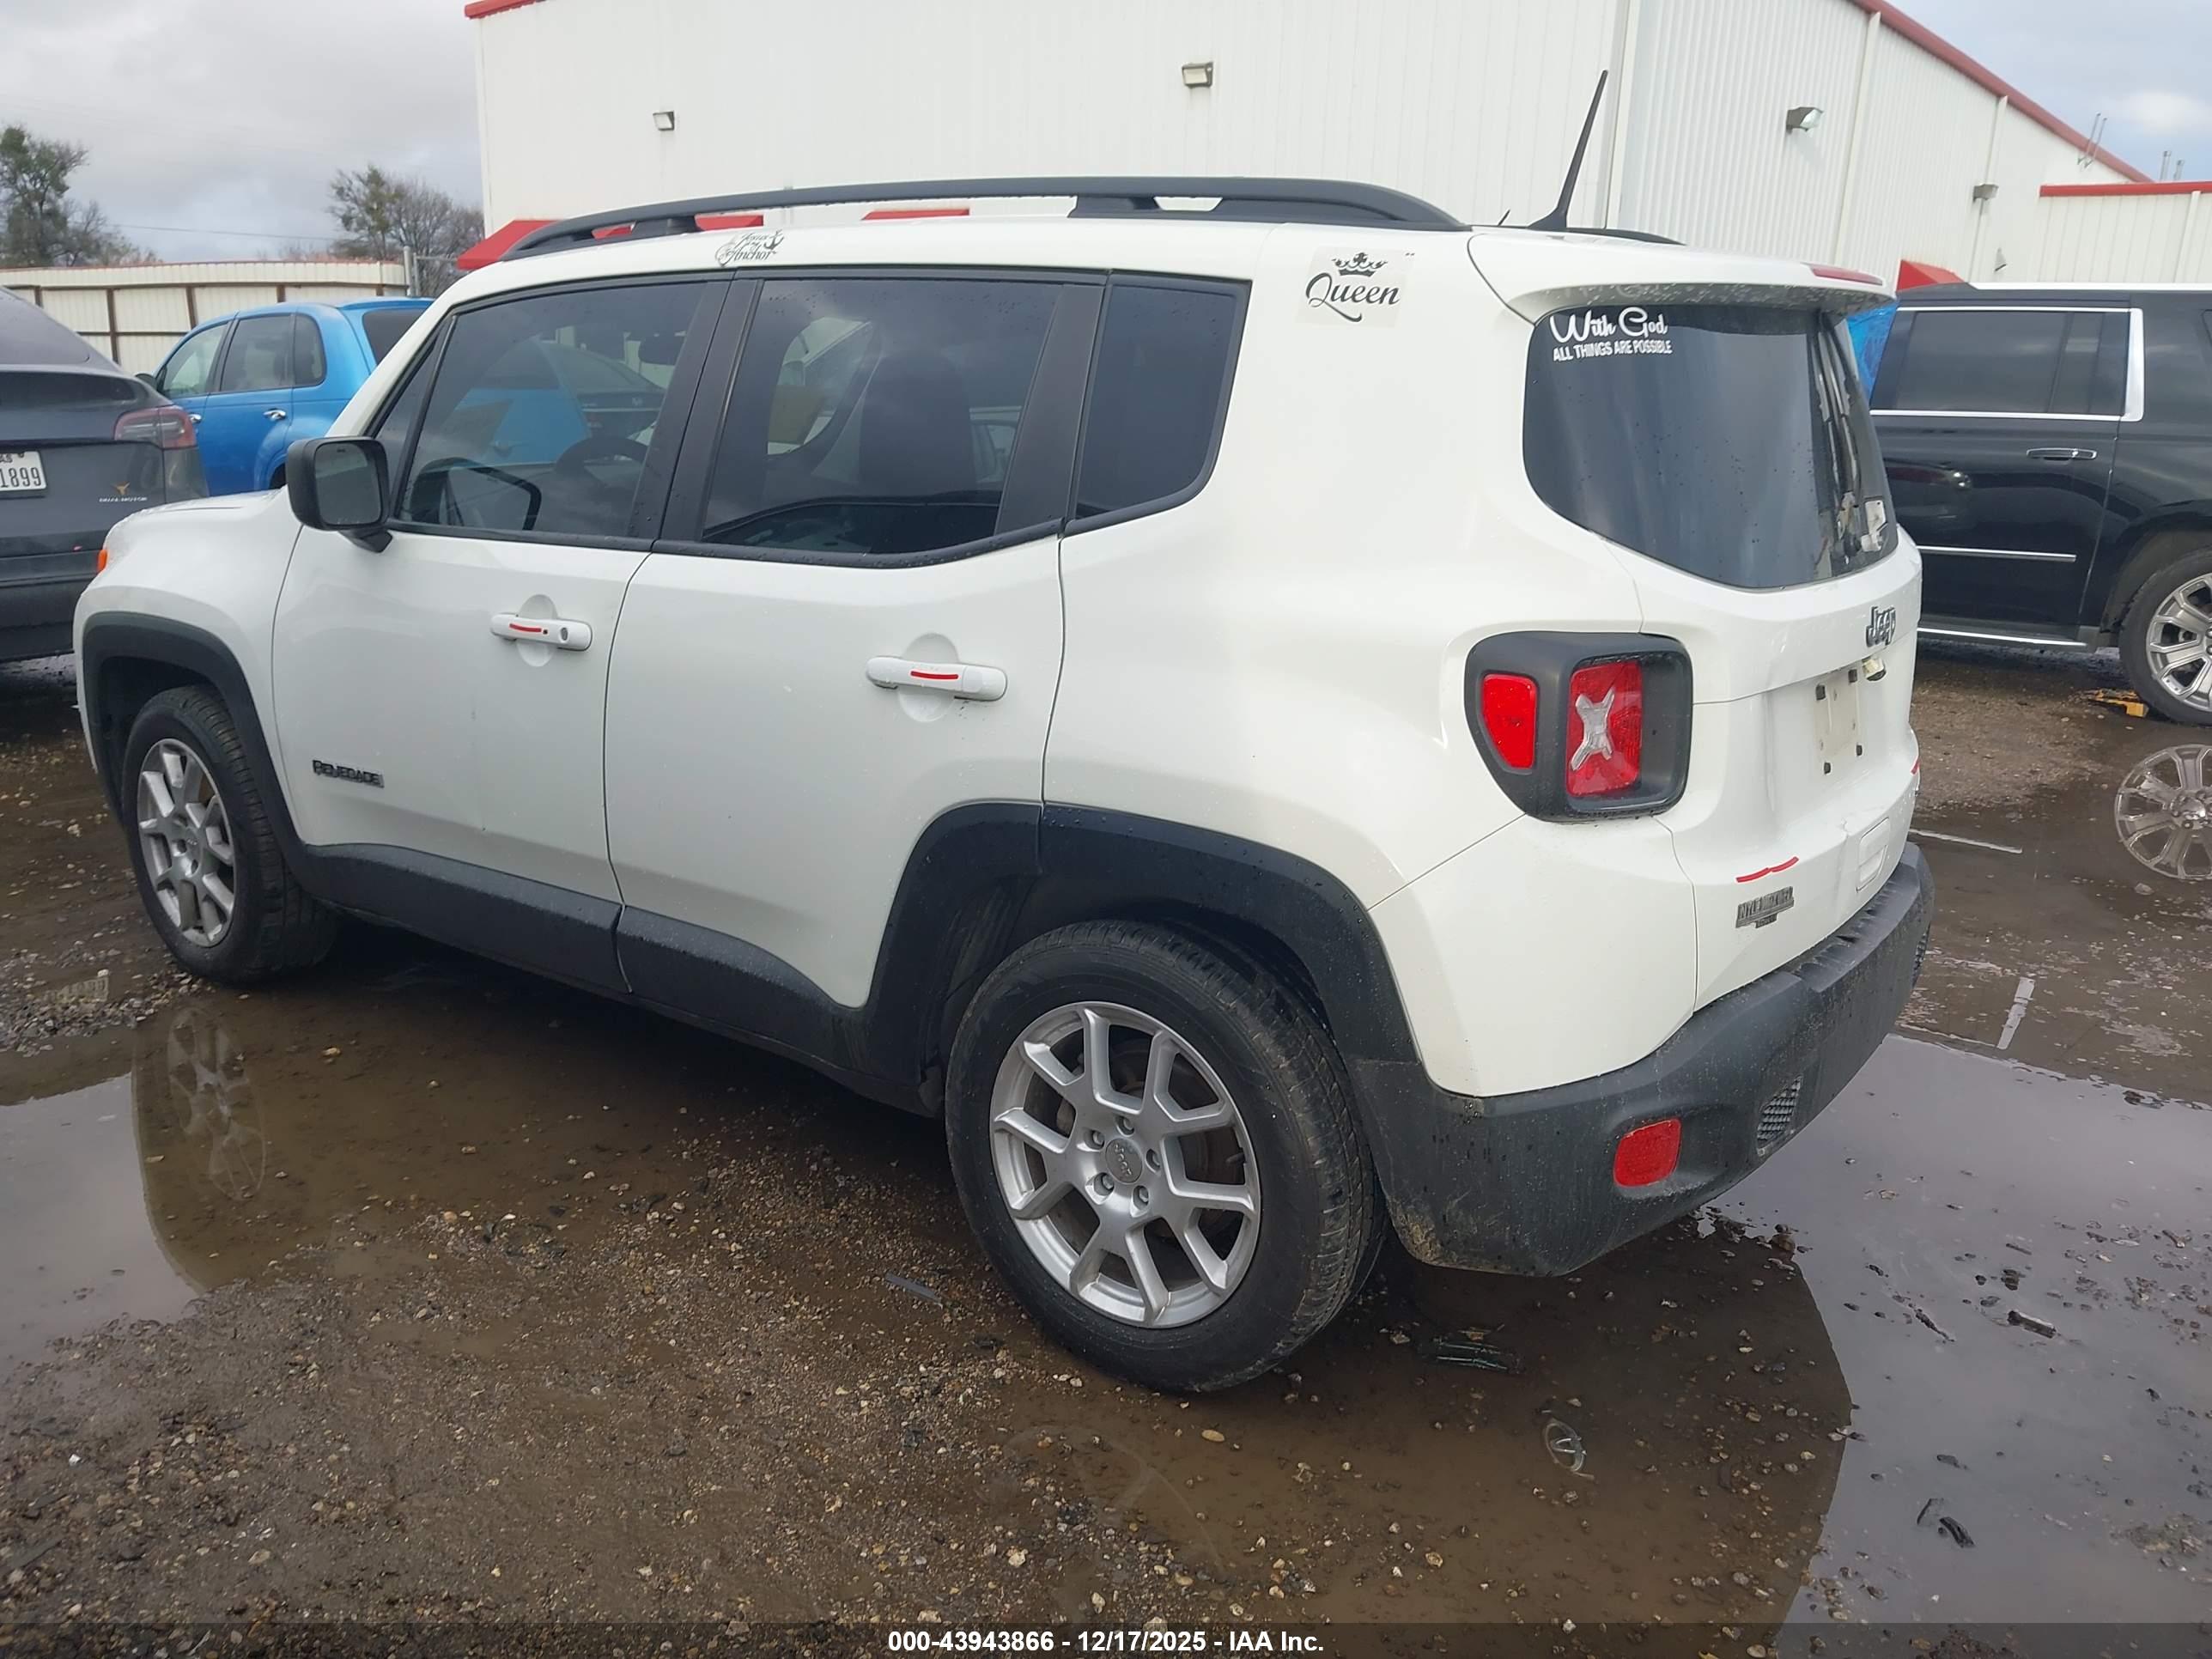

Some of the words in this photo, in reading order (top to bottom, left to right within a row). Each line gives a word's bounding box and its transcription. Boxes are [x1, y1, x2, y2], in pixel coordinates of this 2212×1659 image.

[719, 243, 776, 265] Anchor
[1305, 272, 1400, 322] Queen
[1549, 309, 1617, 343] With
[1619, 307, 1668, 337] God
[1553, 346, 1574, 362] ALL
[1573, 342, 1613, 359] THINGS
[1613, 339, 1633, 355] ARE
[1633, 339, 1673, 355] POSSIBLE
[0, 467, 41, 488] 1899
[1865, 605, 1896, 647] Jeep
